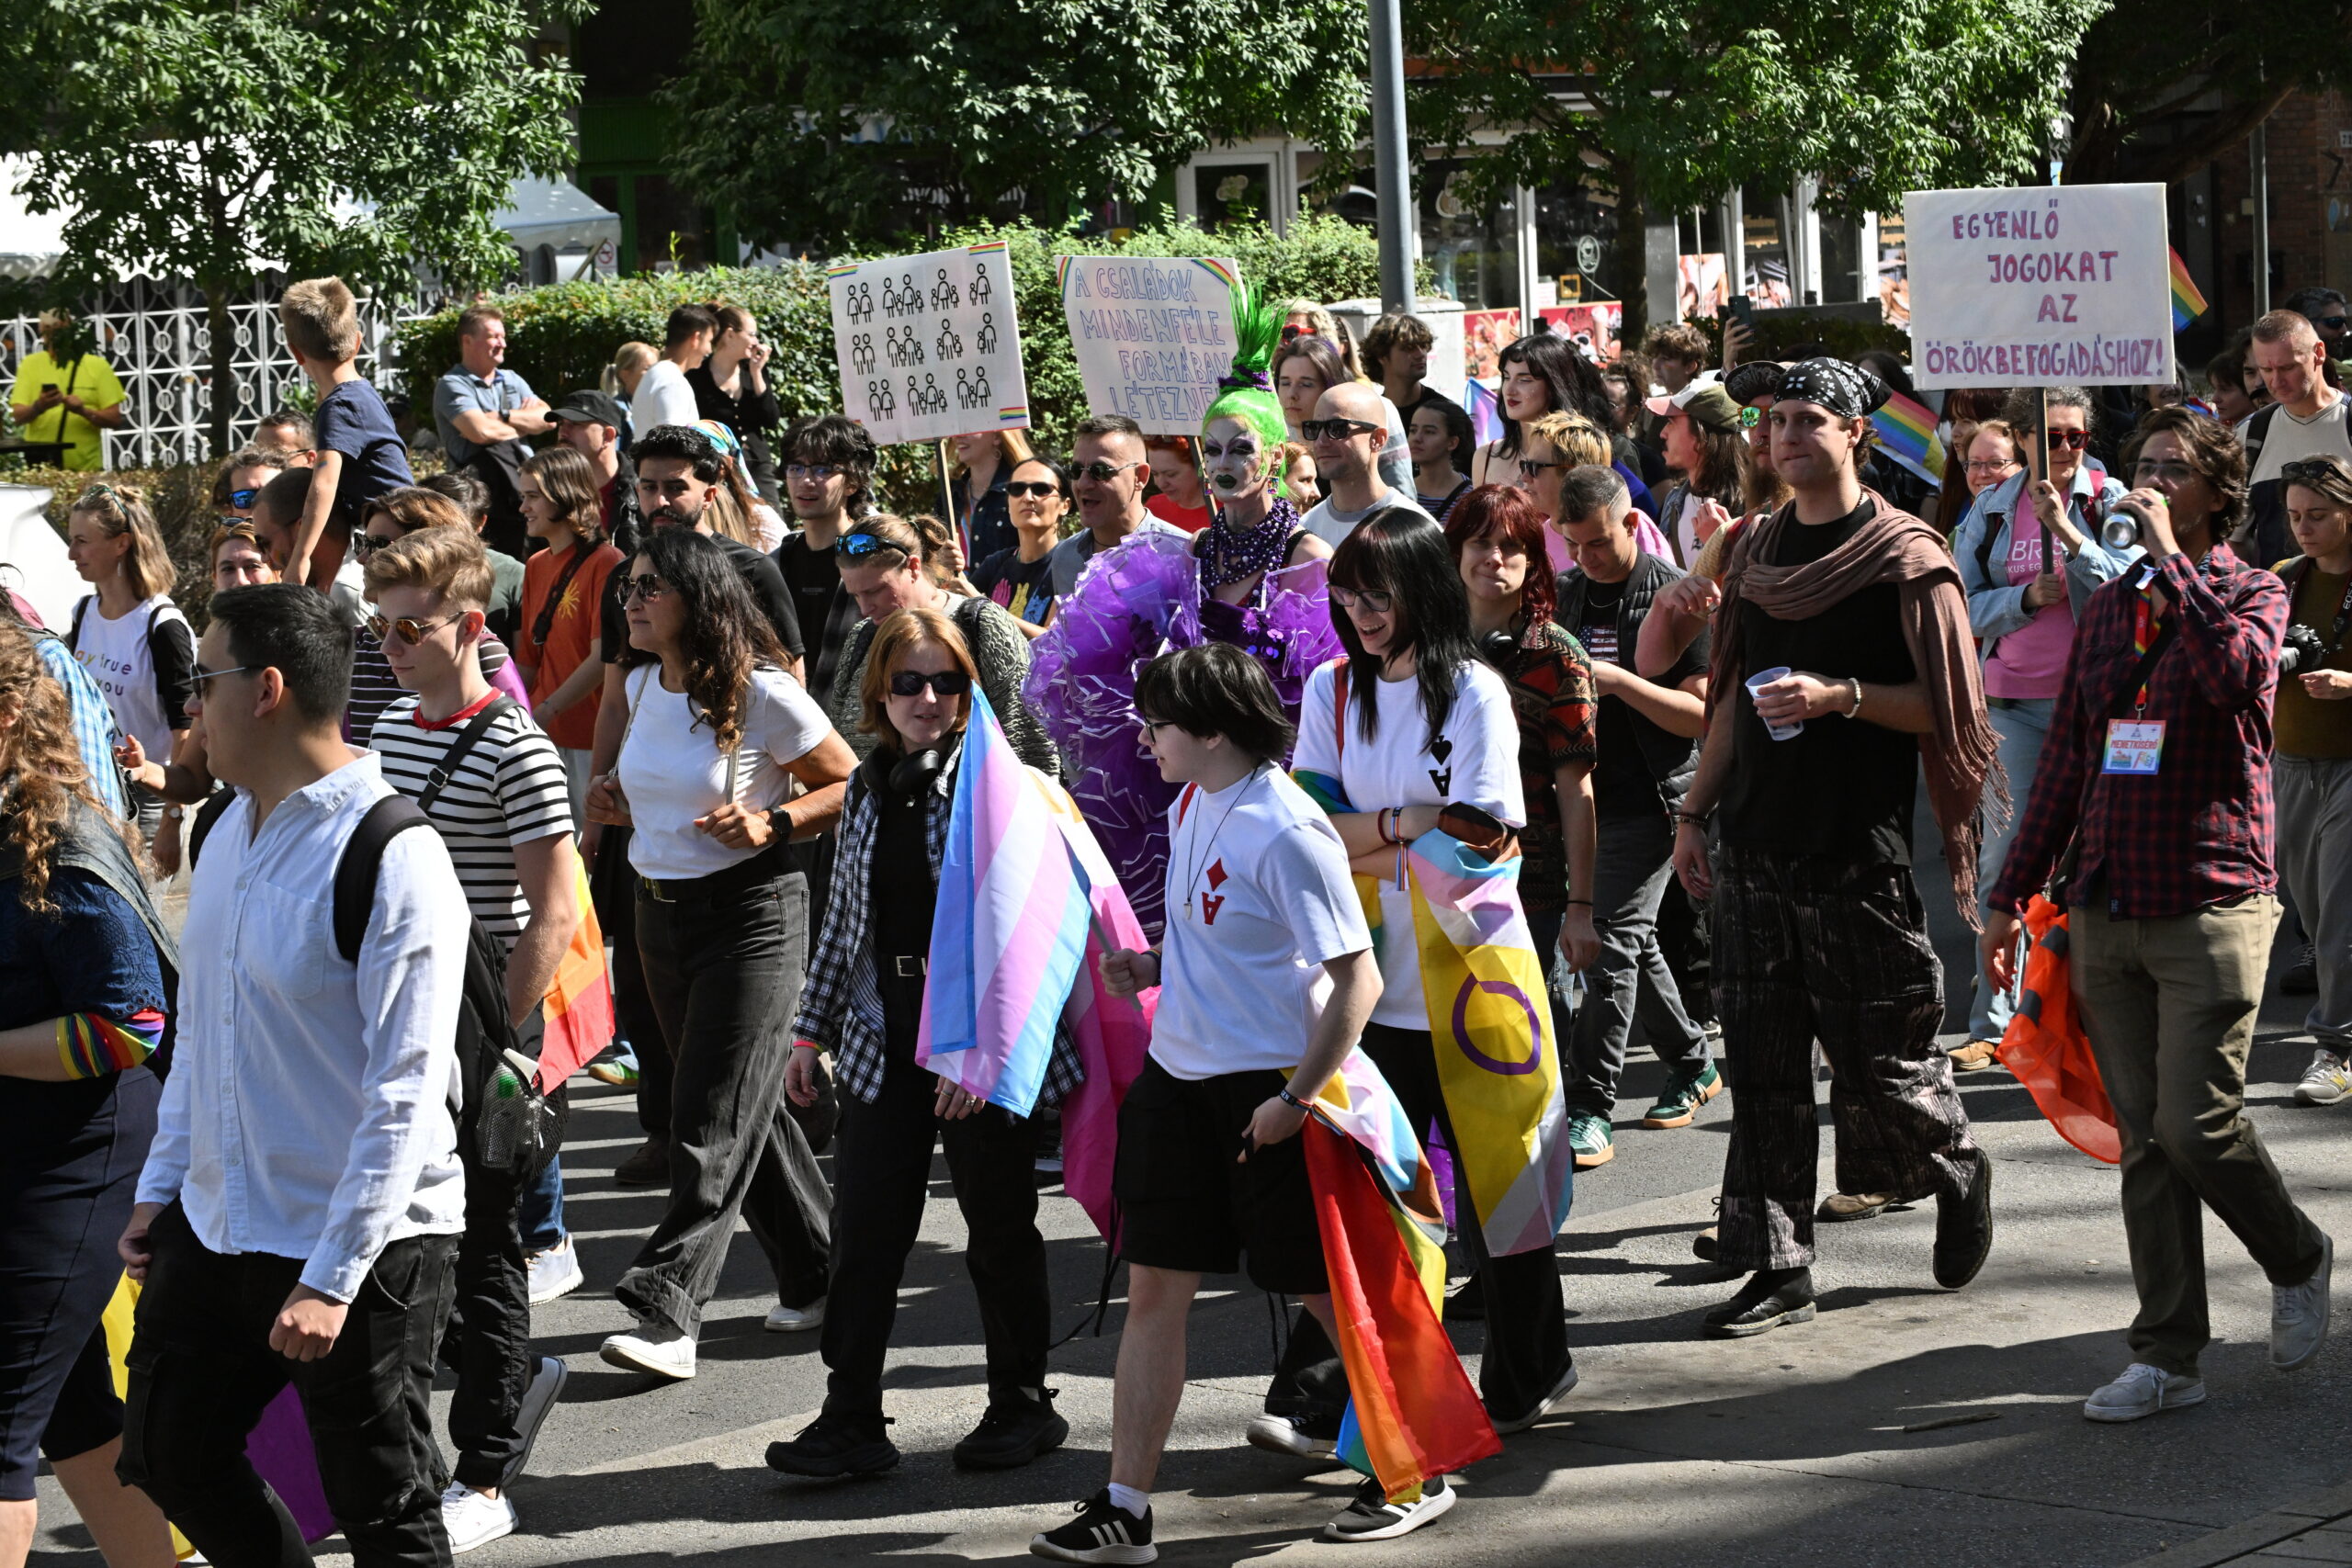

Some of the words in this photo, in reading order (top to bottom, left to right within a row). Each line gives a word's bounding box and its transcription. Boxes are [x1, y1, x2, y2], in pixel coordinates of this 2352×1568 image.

[1952, 198, 2059, 240] EGYENLŐ
[1075, 266, 1091, 298] A
[1096, 260, 1198, 302] CSALÁDOK
[1987, 251, 2119, 283] JOGOKAT
[1080, 305, 1226, 345] MINDENFÉLE
[2037, 293, 2078, 323] AZ
[1118, 346, 1232, 384] FORMÁBAN
[1926, 333, 2163, 378] ÖRÖKBEFOGADÁSHOZ!
[1109, 380, 1220, 423] LÉTEZNE
[100, 653, 132, 675] true
